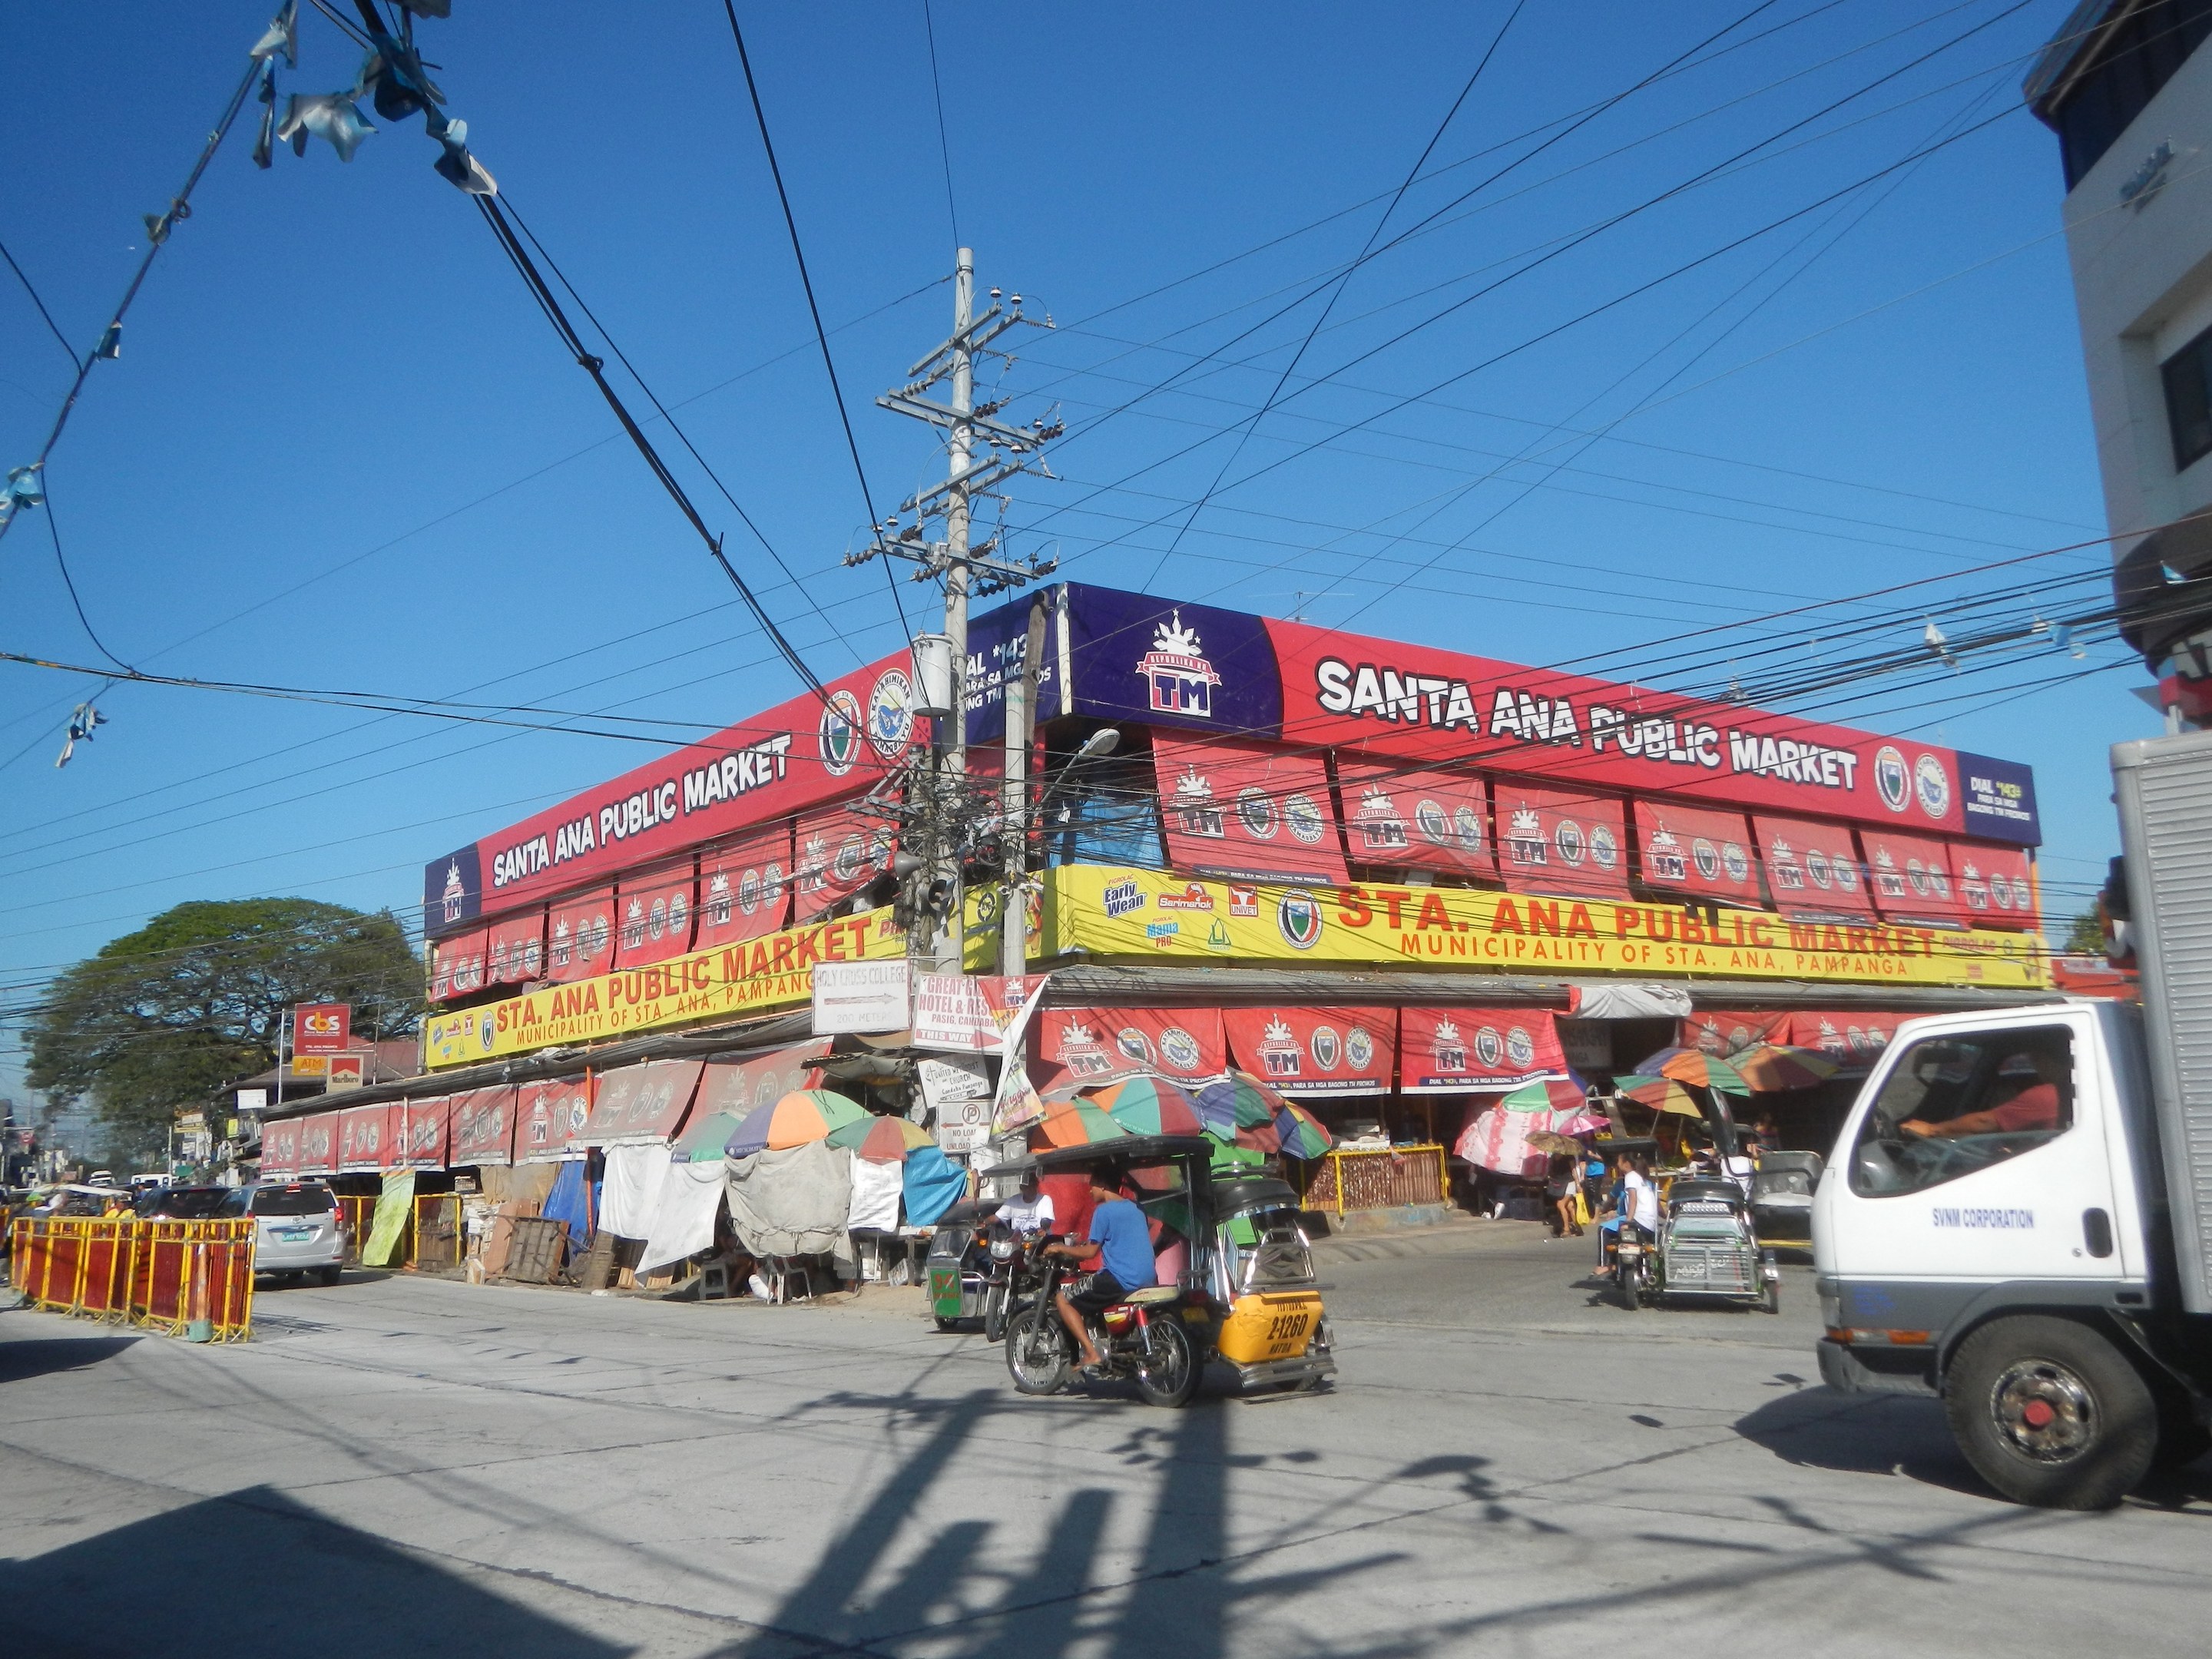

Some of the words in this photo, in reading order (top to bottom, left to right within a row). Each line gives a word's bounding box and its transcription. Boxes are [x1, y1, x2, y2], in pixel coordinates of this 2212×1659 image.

[966, 652, 986, 677] AL
[1150, 655, 1194, 667] REPUBLIKA
[1155, 674, 1208, 711] TM
[1316, 657, 1481, 731] SANTA
[1488, 688, 1584, 747] ANA
[1588, 705, 1722, 768] PUBLIC
[1728, 728, 1858, 791] MARKET
[492, 836, 550, 888] SANTA
[554, 816, 595, 863] ANA
[600, 782, 677, 846] PUBLIC
[684, 734, 792, 813] MARKET
[1365, 823, 1406, 843] TM
[1514, 841, 1545, 861] TM
[1655, 856, 1684, 876] TM
[1108, 874, 1134, 885] PIGROLAC
[1104, 882, 1137, 903] Early
[1106, 895, 1144, 917] Wean
[1160, 897, 1212, 909] Sarimanok
[1231, 906, 1257, 916] UNIVET
[1147, 922, 1178, 937] Mama
[1337, 889, 1469, 932] STA.
[1491, 898, 1598, 939] ANA
[1614, 906, 1773, 948] PUBLIC
[1788, 922, 1936, 959] MARKET
[1155, 935, 1172, 948] PRO
[1401, 933, 1604, 961] MUNICIPALITY
[1621, 944, 1651, 963] OF
[1665, 947, 1716, 966] STA.
[1730, 950, 1783, 972] ANA,
[1796, 954, 1908, 975] PAMPANGA
[497, 998, 542, 1033] STA.
[551, 983, 599, 1021] ANA
[608, 955, 711, 1008] PUBLIC
[724, 918, 872, 985] MARKET
[816, 969, 838, 988] HOLY
[840, 969, 867, 986] CROSS
[869, 965, 906, 985] COLLEGE
[928, 976, 961, 995] GREAT
[517, 1014, 603, 1045] MUNICIPALITY
[611, 1008, 627, 1027] OF
[636, 1002, 667, 1023] STA.
[677, 992, 717, 1014] ANA,
[727, 972, 813, 1005] PAMPANG
[919, 994, 953, 1012] HOTEL
[955, 999, 963, 1014] &
[1006, 995, 1026, 1006] TM
[837, 1014, 854, 1024] 200
[932, 1014, 957, 1025] PASIG,
[959, 1016, 995, 1028] CANDABA
[921, 1030, 945, 1041] THIS
[949, 1032, 972, 1043] WAY
[301, 1058, 322, 1068] ATM
[1069, 1055, 1112, 1075] TM
[1268, 1053, 1299, 1072] TM
[1439, 1051, 1464, 1068] TM
[332, 1074, 359, 1084] Marlboro
[935, 1068, 952, 1079] UNITED
[949, 1073, 972, 1085] CHURCH
[1933, 1208, 1960, 1227] SVNM
[1963, 1208, 2035, 1228] CORPORATION
[1267, 1313, 1309, 1340] 2-1260
